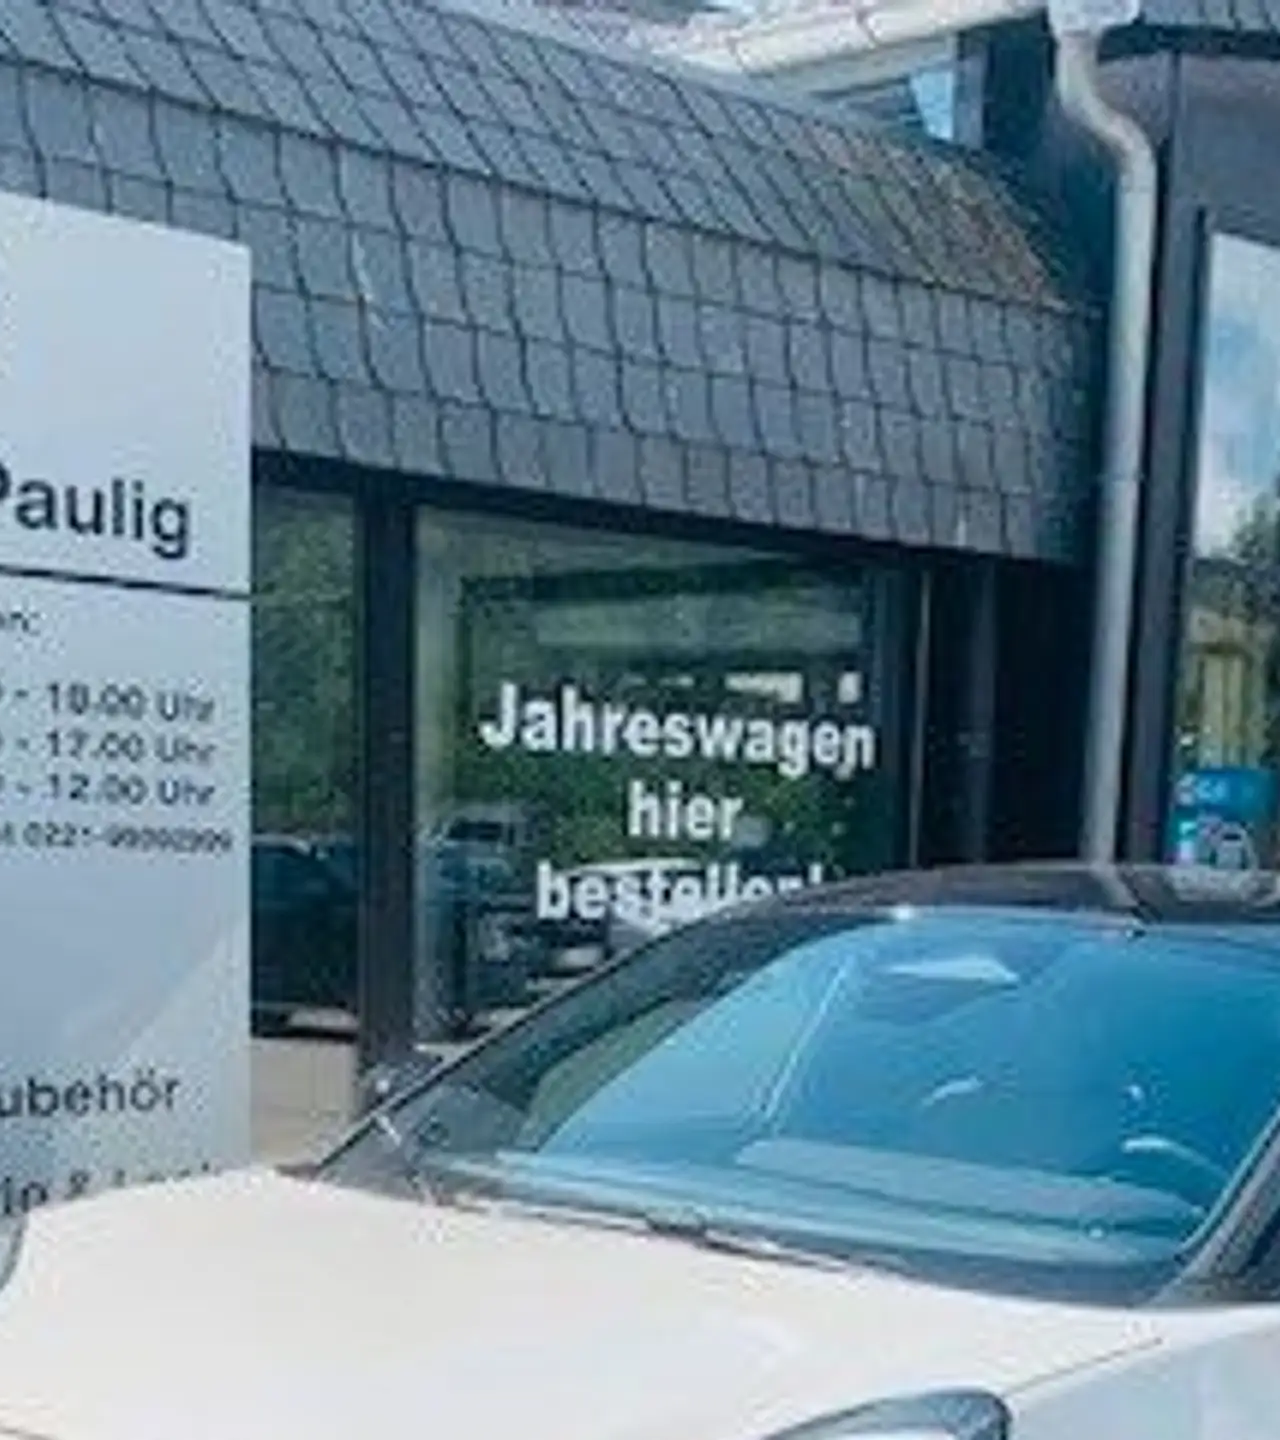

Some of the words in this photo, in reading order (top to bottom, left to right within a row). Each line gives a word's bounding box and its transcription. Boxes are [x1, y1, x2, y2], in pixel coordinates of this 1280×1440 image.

[157, 690, 216, 722] Uhr
[154, 732, 218, 764] Uhr
[480, 682, 875, 781] Jahreswagen
[47, 772, 149, 805] 12.00
[158, 777, 216, 806] Uhr
[628, 779, 744, 840] hier
